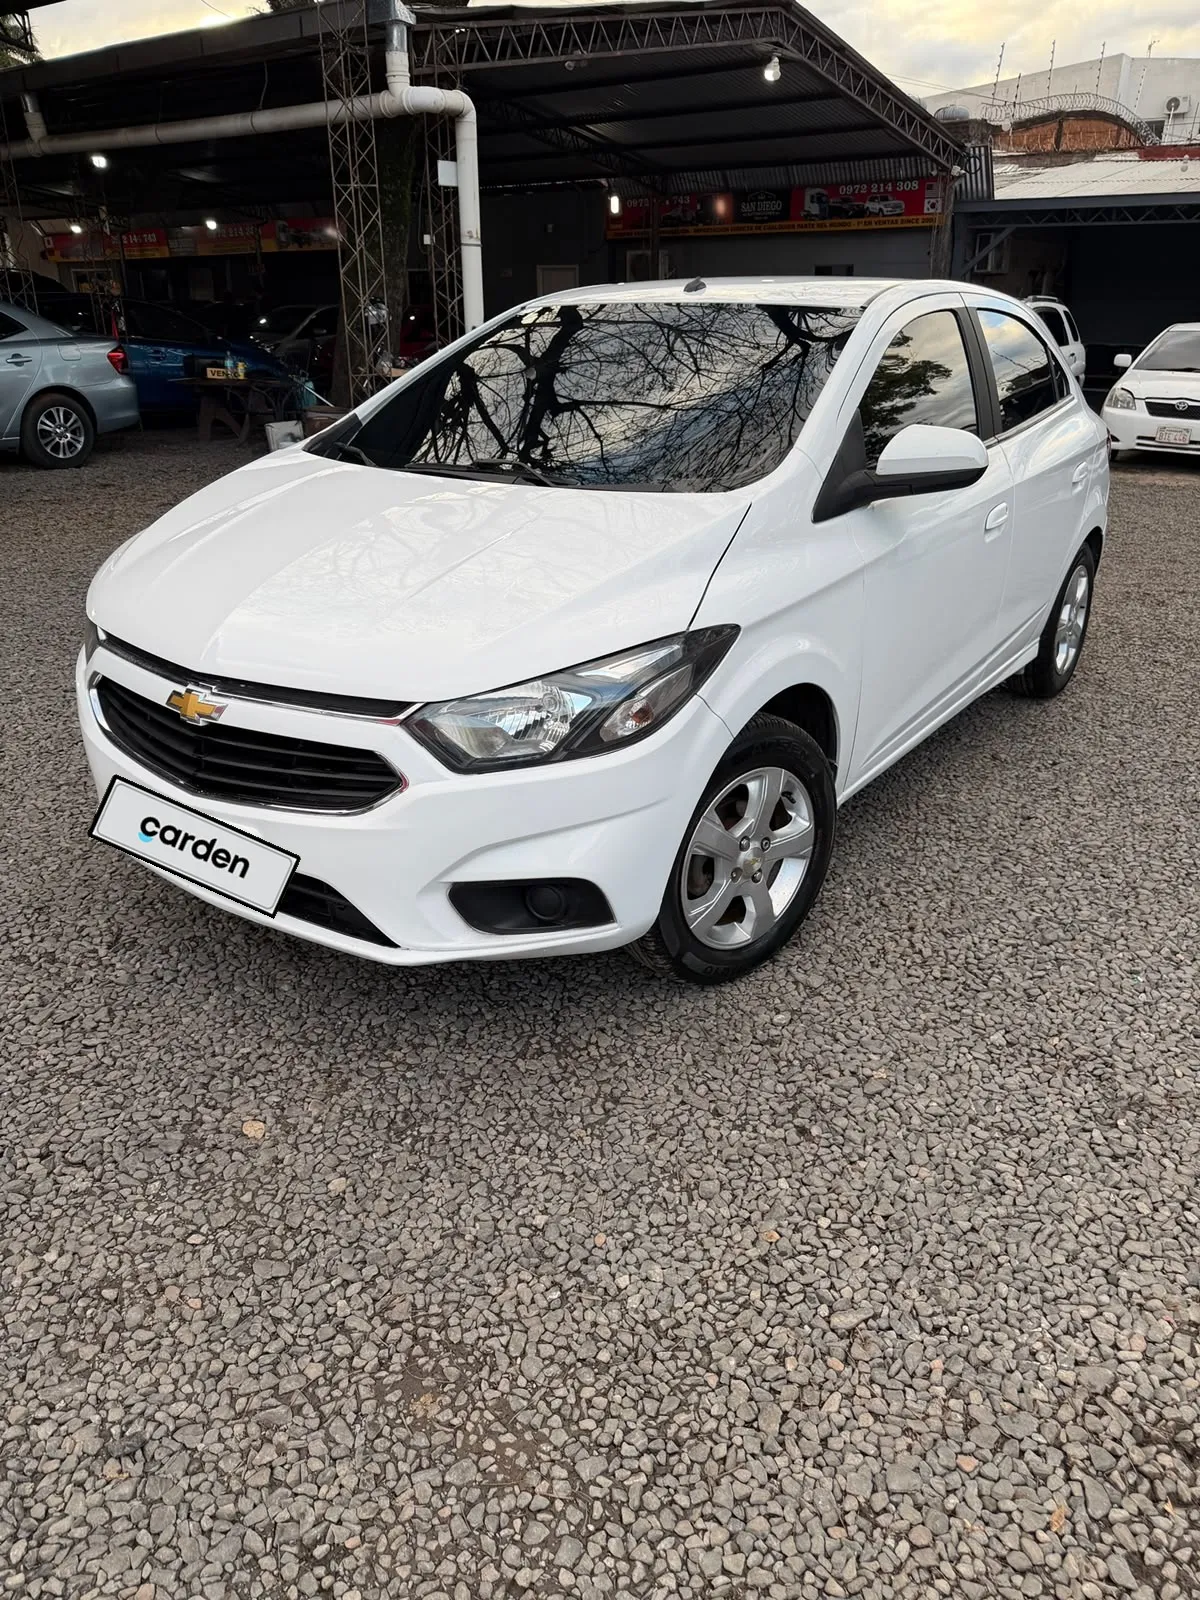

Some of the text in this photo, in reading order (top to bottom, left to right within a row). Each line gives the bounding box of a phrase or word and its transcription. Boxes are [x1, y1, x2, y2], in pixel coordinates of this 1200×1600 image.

[839, 180, 918, 195] 0972 214 308
[740, 199, 783, 213] SAN DIEGO
